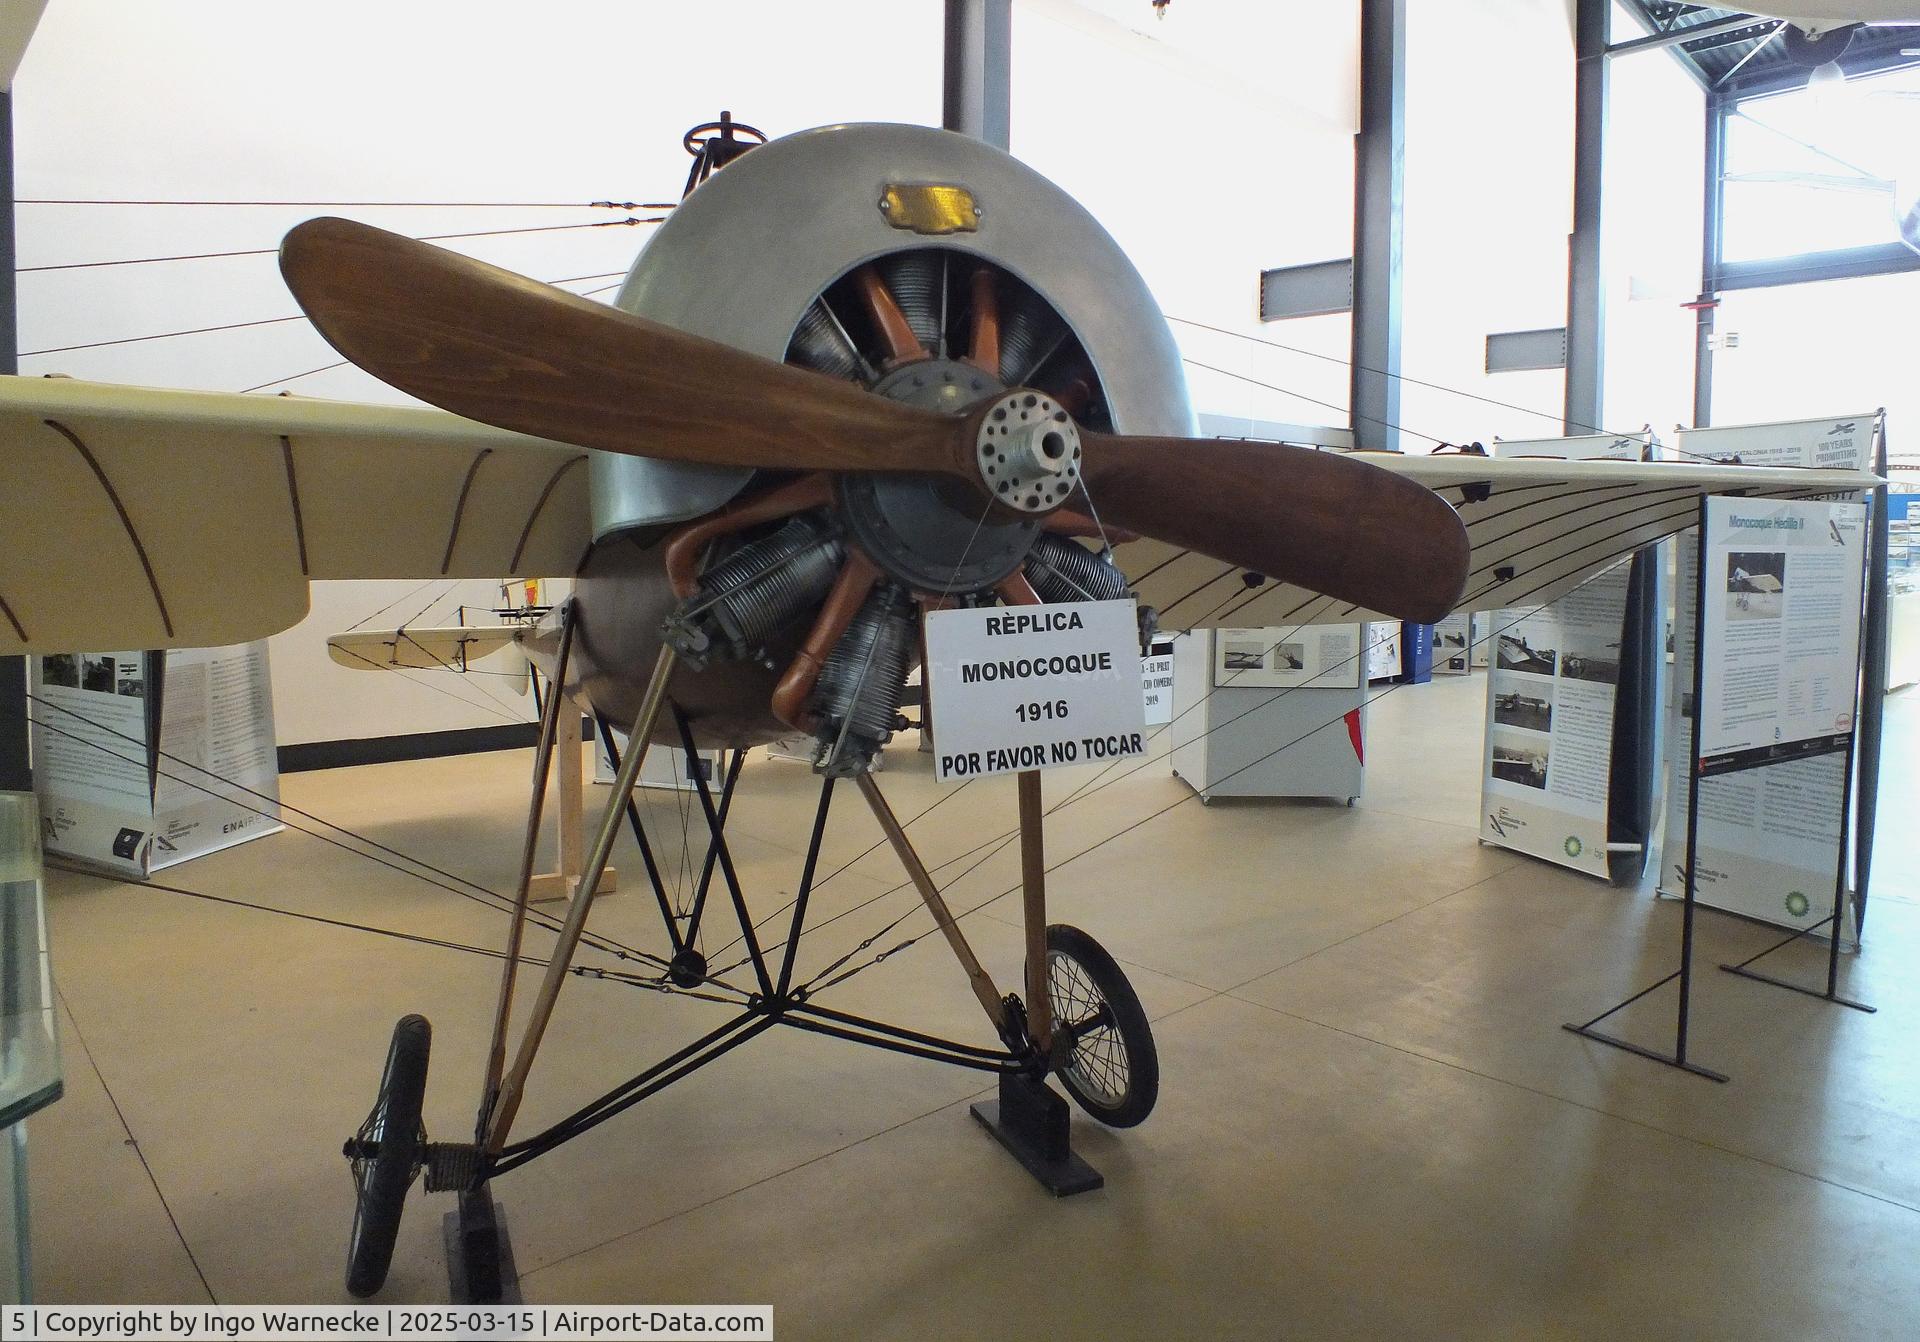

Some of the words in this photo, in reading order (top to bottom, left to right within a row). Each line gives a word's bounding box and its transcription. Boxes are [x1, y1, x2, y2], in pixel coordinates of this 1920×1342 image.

[1729, 515, 1772, 532] Monocoque
[986, 612, 1084, 636] RÈPLICA
[962, 652, 1112, 683] MONOCOQUE
[1015, 700, 1069, 722] 1916
[1146, 696, 1158, 705] 2019
[942, 753, 981, 777] POR
[987, 744, 1046, 772] FAVOR
[1051, 741, 1077, 763] NO
[1082, 733, 1143, 759] TOCAR
